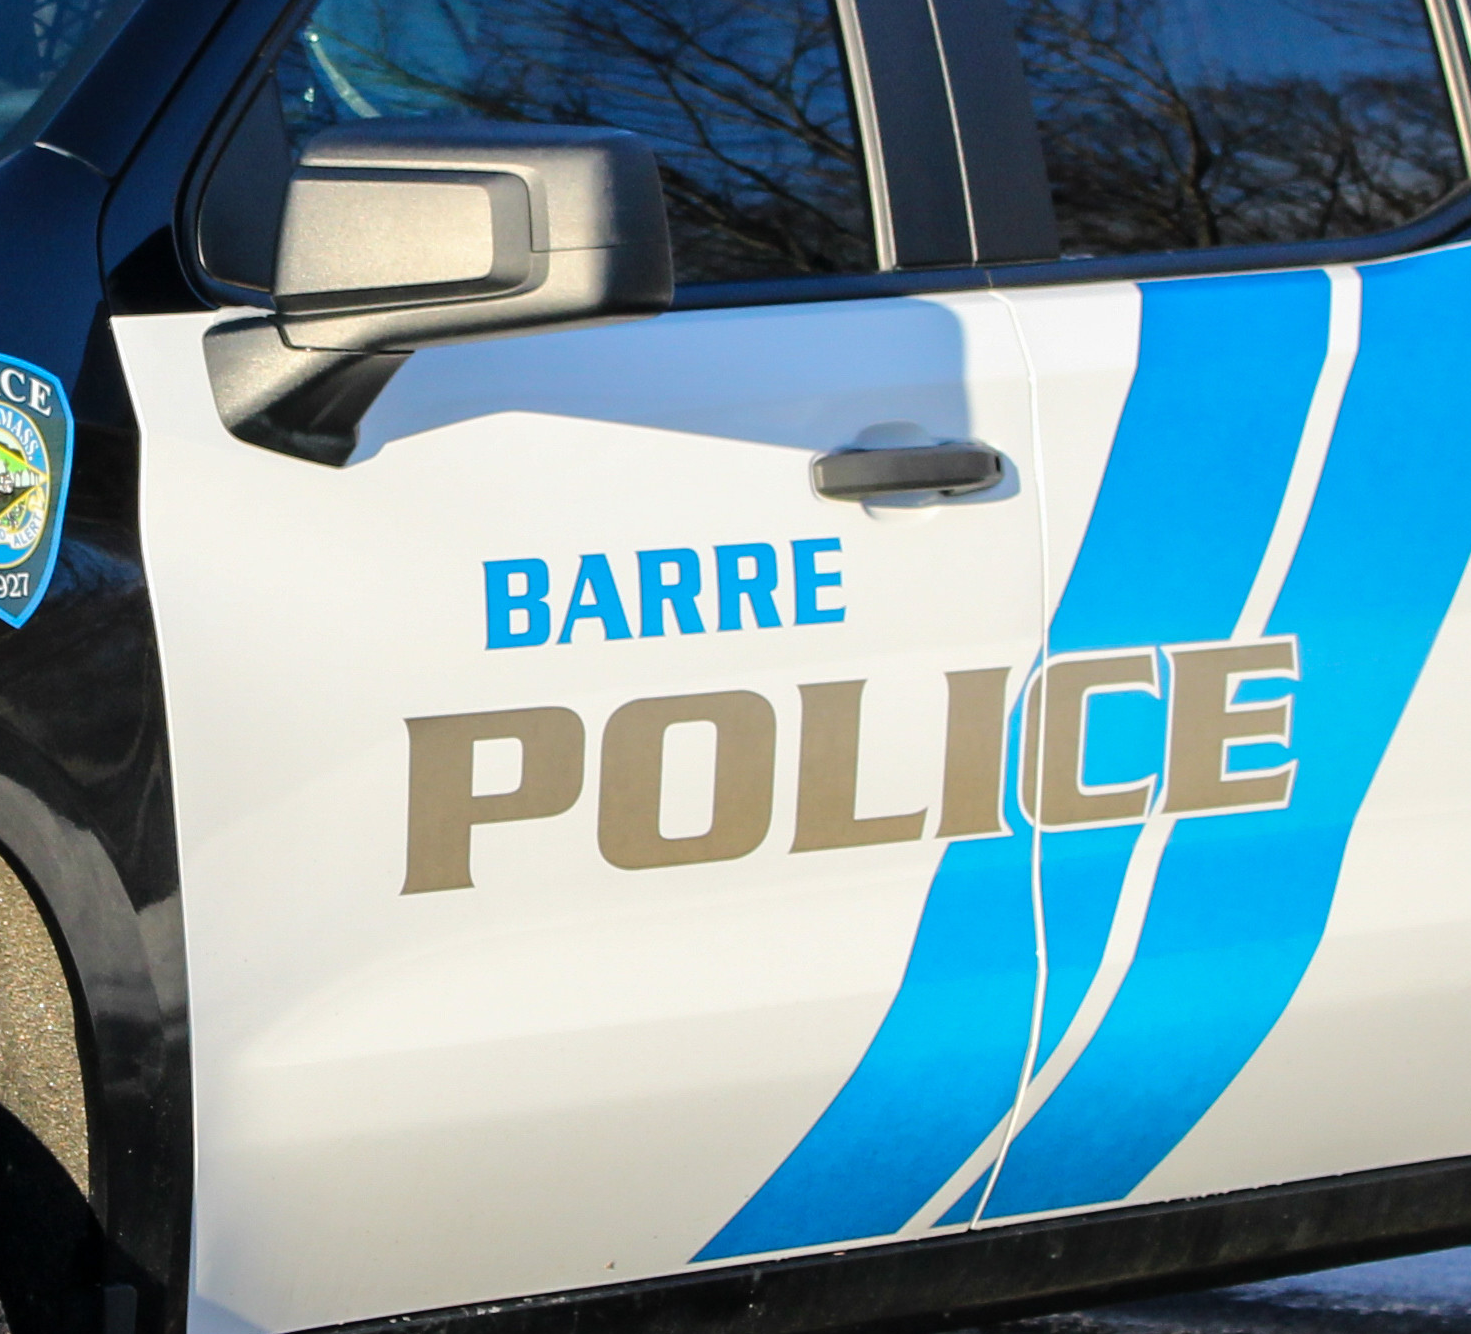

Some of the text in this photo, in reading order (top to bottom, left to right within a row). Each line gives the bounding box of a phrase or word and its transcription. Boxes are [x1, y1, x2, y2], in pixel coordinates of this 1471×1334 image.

[13, 514, 43, 547] ALERT
[483, 536, 847, 651] BARRE
[398, 633, 1301, 896] POLICE
